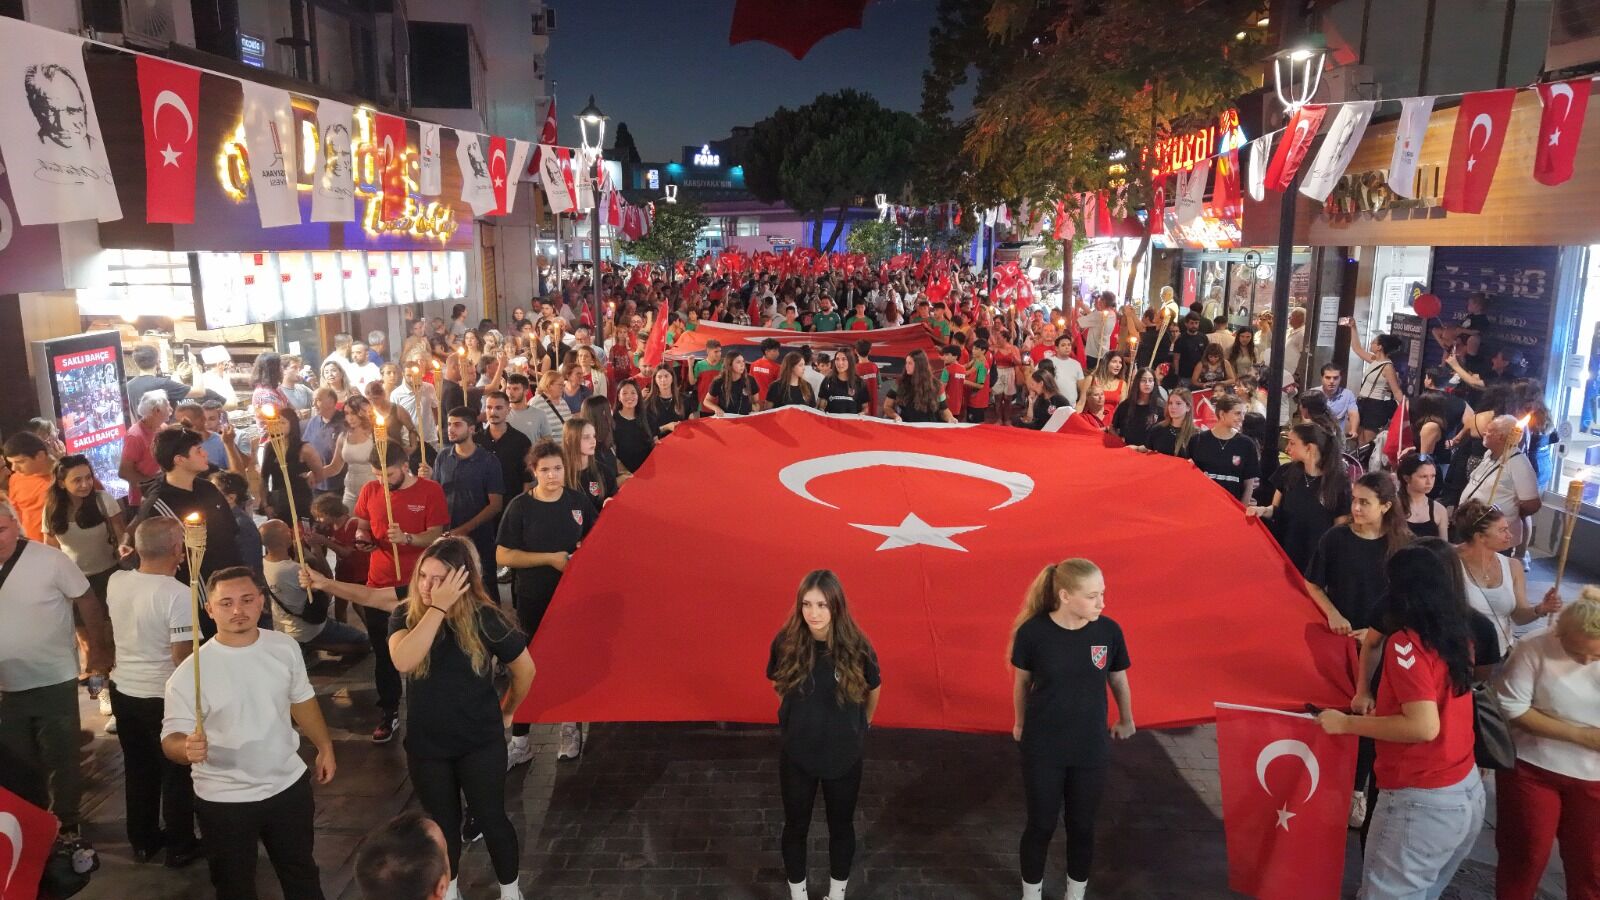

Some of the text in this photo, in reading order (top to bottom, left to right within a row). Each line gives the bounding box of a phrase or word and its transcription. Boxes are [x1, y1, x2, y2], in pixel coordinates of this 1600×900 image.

[694, 153, 720, 166] FORS
[62, 351, 110, 367] SAKLI BAHÇE
[73, 427, 119, 448] SAKLI BAHÇE
